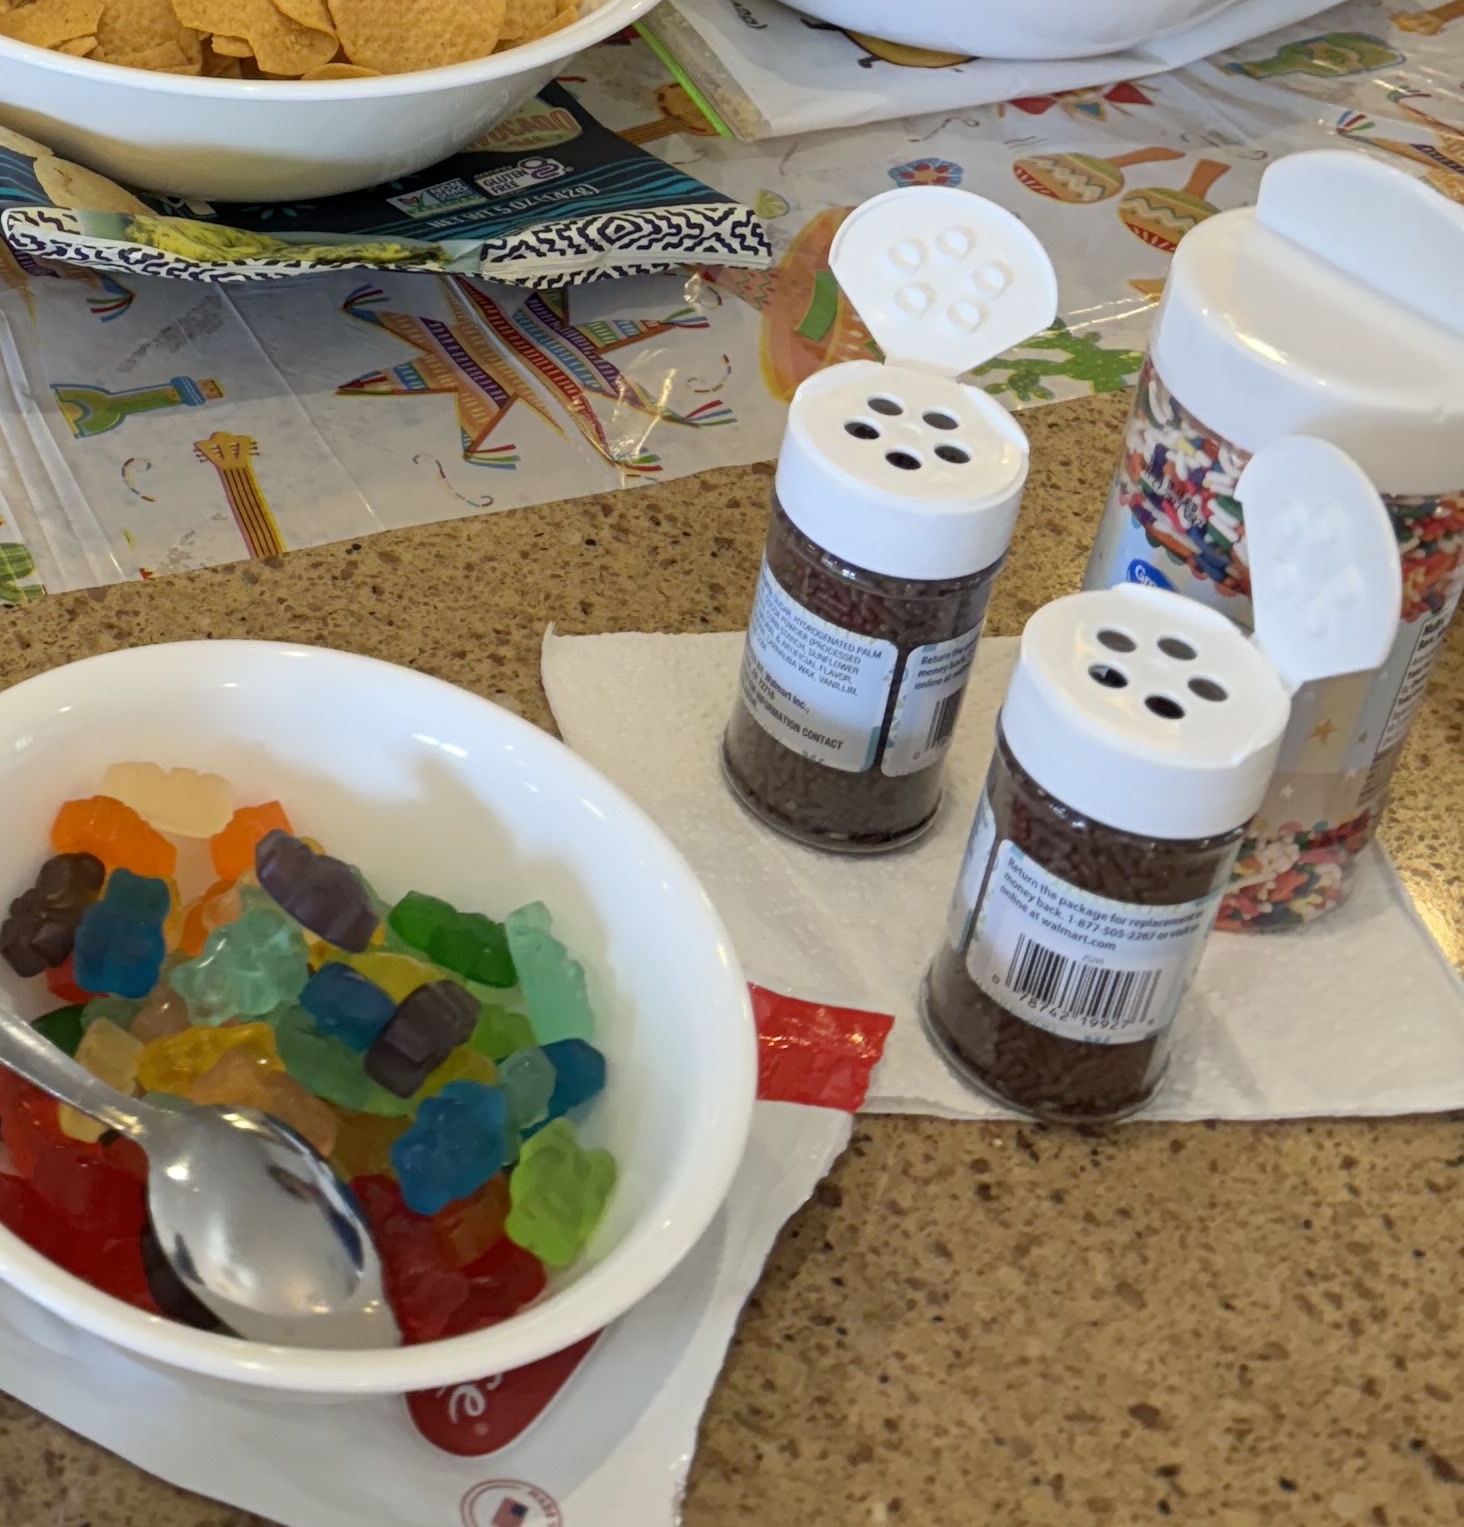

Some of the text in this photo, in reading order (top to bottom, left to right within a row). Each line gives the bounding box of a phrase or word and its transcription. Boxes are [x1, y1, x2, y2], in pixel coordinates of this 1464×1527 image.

[483, 169, 528, 187] GLUTEN
[489, 180, 520, 194] FREE
[428, 211, 463, 228] NET
[495, 202, 512, 215] 5
[511, 194, 536, 210] OZ
[793, 615, 855, 652] HYDROGENATED
[856, 646, 883, 659] PALM
[808, 647, 860, 675] SUNFLOWER
[819, 664, 853, 685] FLAVOR,
[921, 652, 951, 665] Return
[756, 690, 801, 733] INFORMATION
[801, 727, 844, 751] CONTACT
[1003, 872, 1036, 903] money
[1068, 914, 1156, 941] 1-877-505-2267
[1156, 932, 1169, 941] or
[1008, 857, 1038, 889] Return
[1039, 883, 1058, 901] the
[1058, 896, 1109, 922] package
[1109, 912, 1128, 926] for
[999, 884, 1117, 951] online at walmart.com
[1019, 992, 1070, 1022] 78742
